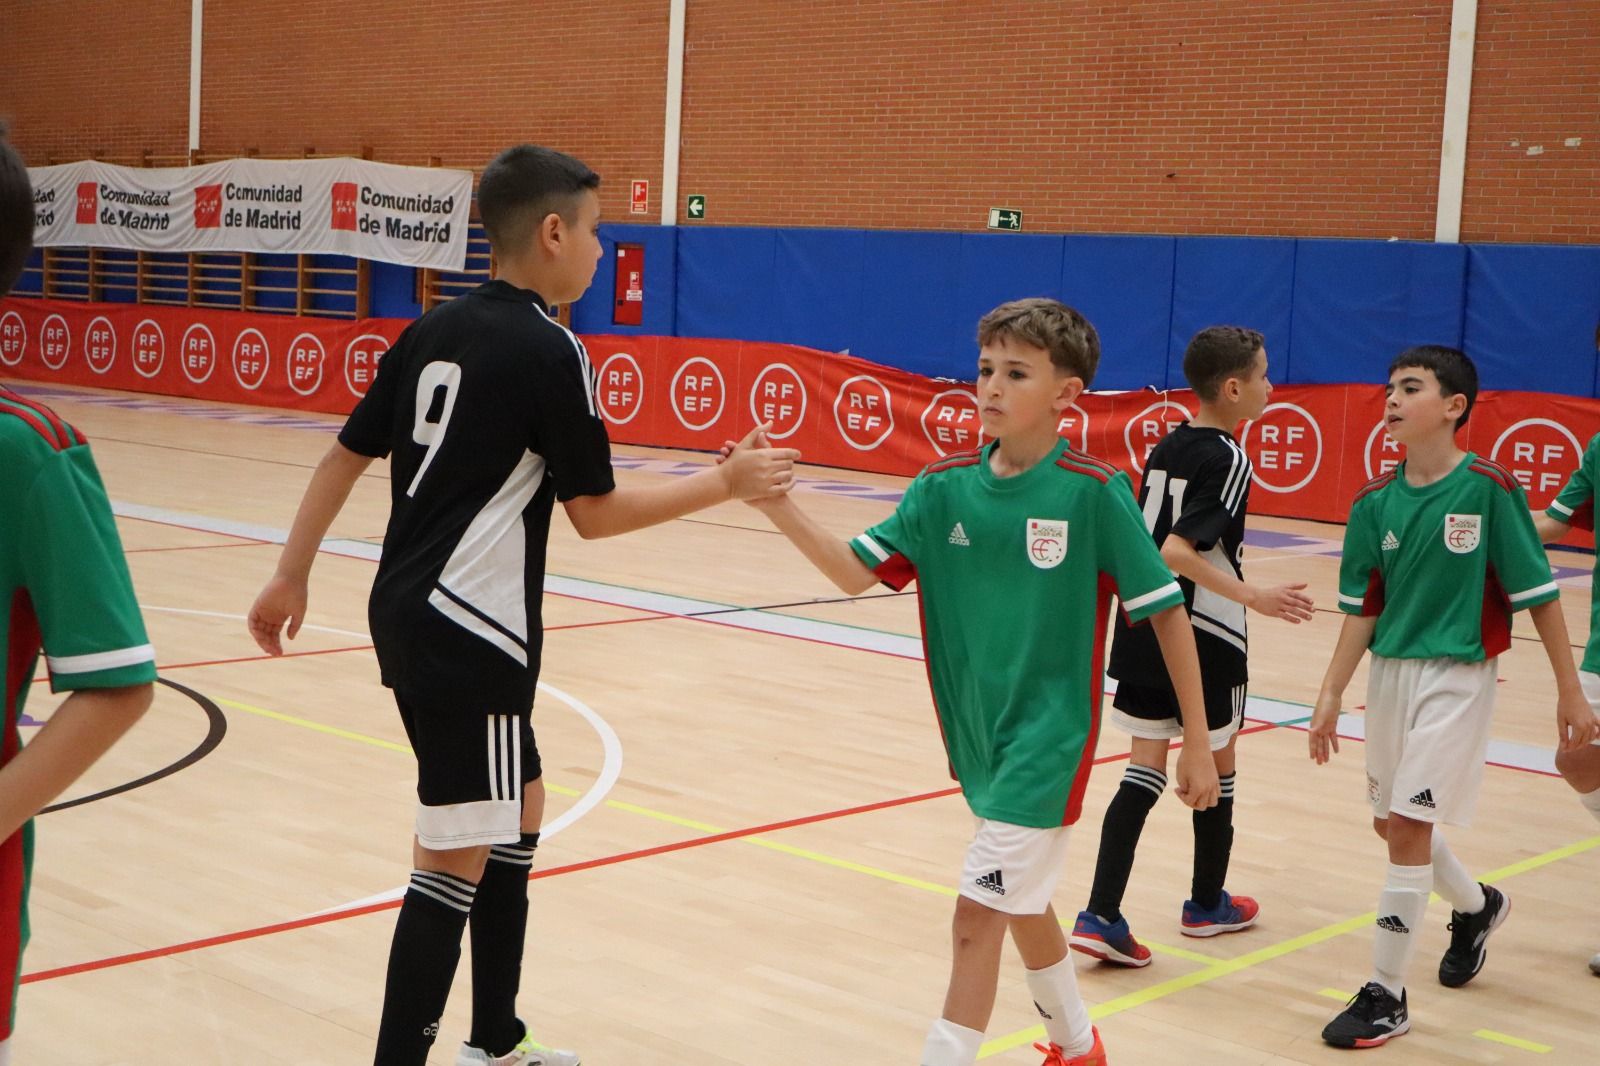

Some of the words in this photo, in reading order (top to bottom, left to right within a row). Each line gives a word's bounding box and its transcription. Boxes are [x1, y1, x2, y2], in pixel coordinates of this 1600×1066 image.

[100, 184, 170, 206] Comunidad
[226, 183, 303, 203] Comunidad
[361, 186, 454, 214] Comunidad
[101, 208, 116, 225] de
[120, 211, 170, 230] Madrid
[224, 208, 242, 227] de
[246, 209, 301, 230] Madrid
[359, 213, 381, 235] de
[386, 217, 450, 243] Madrid
[4, 324, 20, 337] RF
[47, 328, 63, 340] RF
[92, 331, 109, 343] RF
[4, 340, 19, 352] EF
[140, 334, 157, 346] RF
[189, 338, 208, 351] RF
[47, 343, 63, 356] EF
[92, 347, 109, 359] EF
[139, 350, 157, 363] EF
[241, 343, 261, 357] RF
[296, 348, 318, 362] RF
[188, 355, 207, 368] EF
[240, 361, 259, 374] EF
[295, 367, 314, 379] EF
[609, 371, 633, 386] RF
[684, 375, 713, 391] RF
[764, 382, 794, 398] RF
[608, 391, 632, 406] EF
[683, 396, 712, 412] EF
[850, 393, 879, 410] RF
[763, 403, 793, 420] EF
[937, 406, 975, 423] RF
[407, 360, 461, 498] 9
[847, 413, 881, 431] EF
[936, 426, 968, 444] EF
[1261, 424, 1305, 444] RF
[1260, 450, 1303, 470] EF
[1513, 441, 1564, 464] RF
[1512, 469, 1562, 492] EF
[1409, 797, 1436, 809] adidas
[975, 878, 1006, 896] adidas
